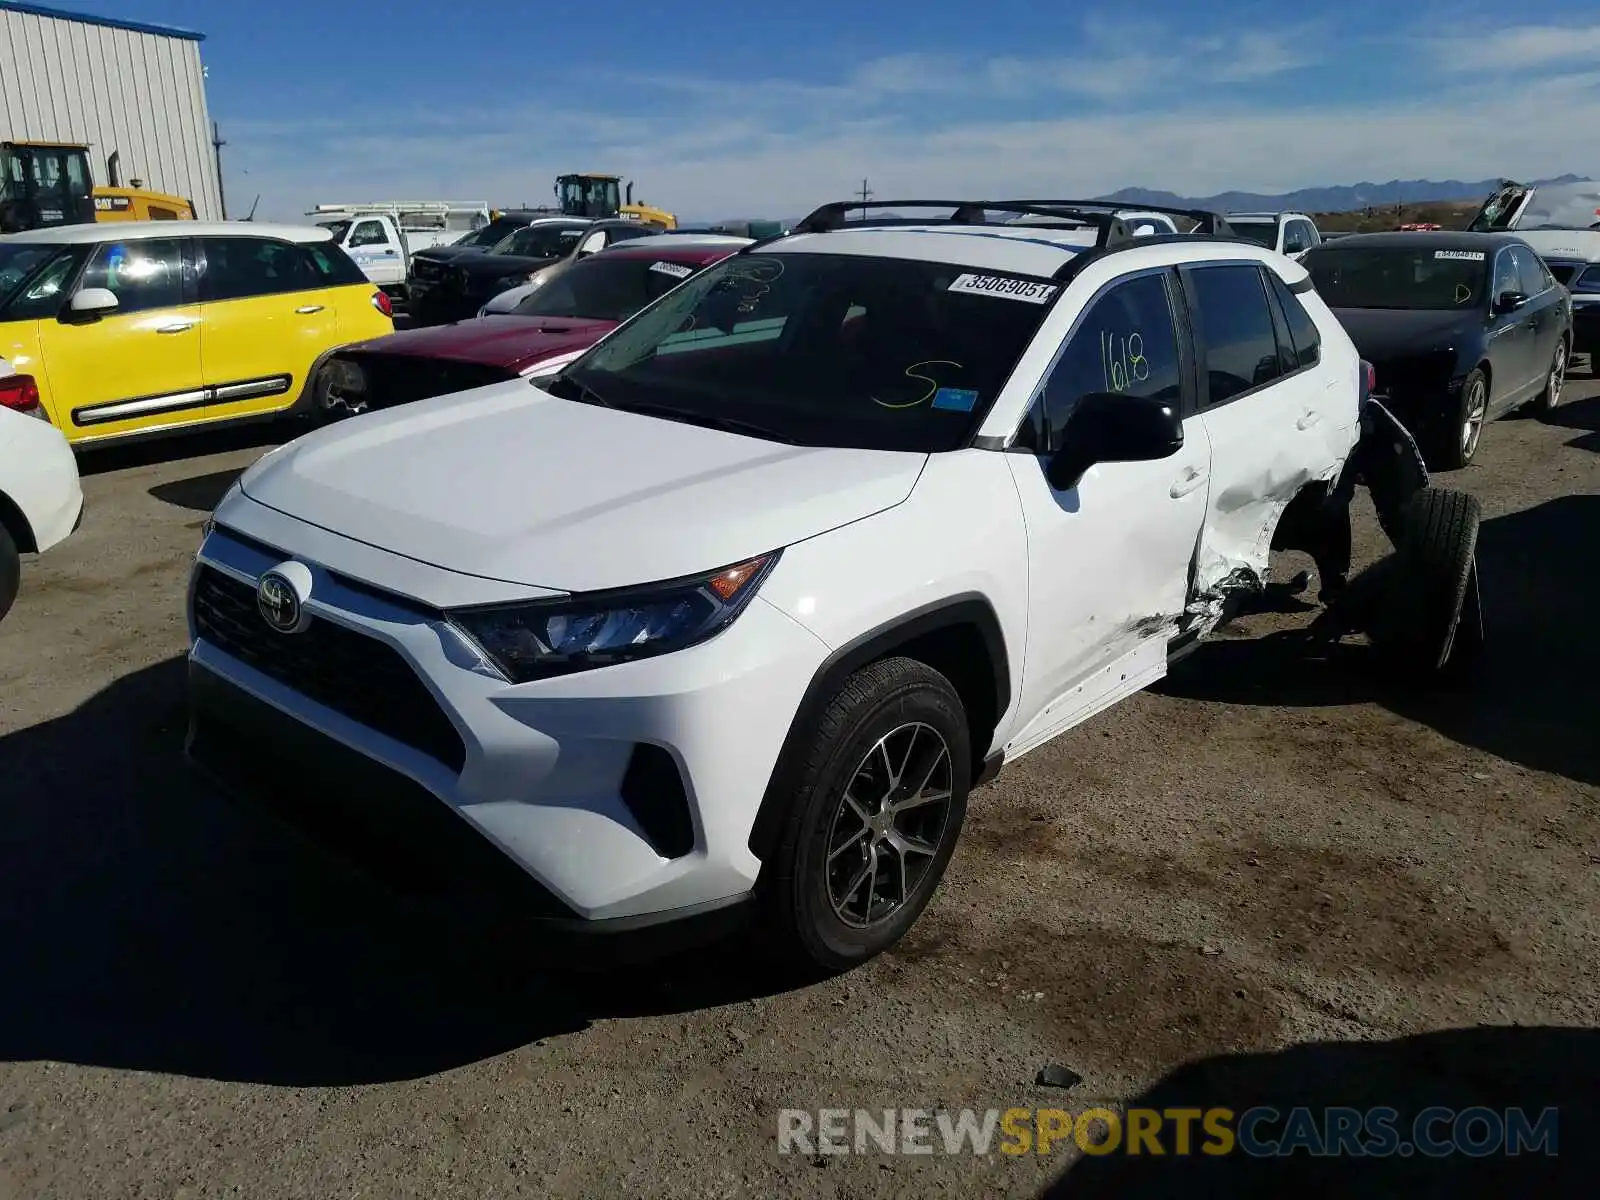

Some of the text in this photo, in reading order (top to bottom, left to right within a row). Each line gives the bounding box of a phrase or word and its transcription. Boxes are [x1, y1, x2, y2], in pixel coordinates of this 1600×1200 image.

[95, 198, 112, 210] CAT
[966, 275, 1050, 298] 35069051
[1101, 330, 1149, 393] 1618
